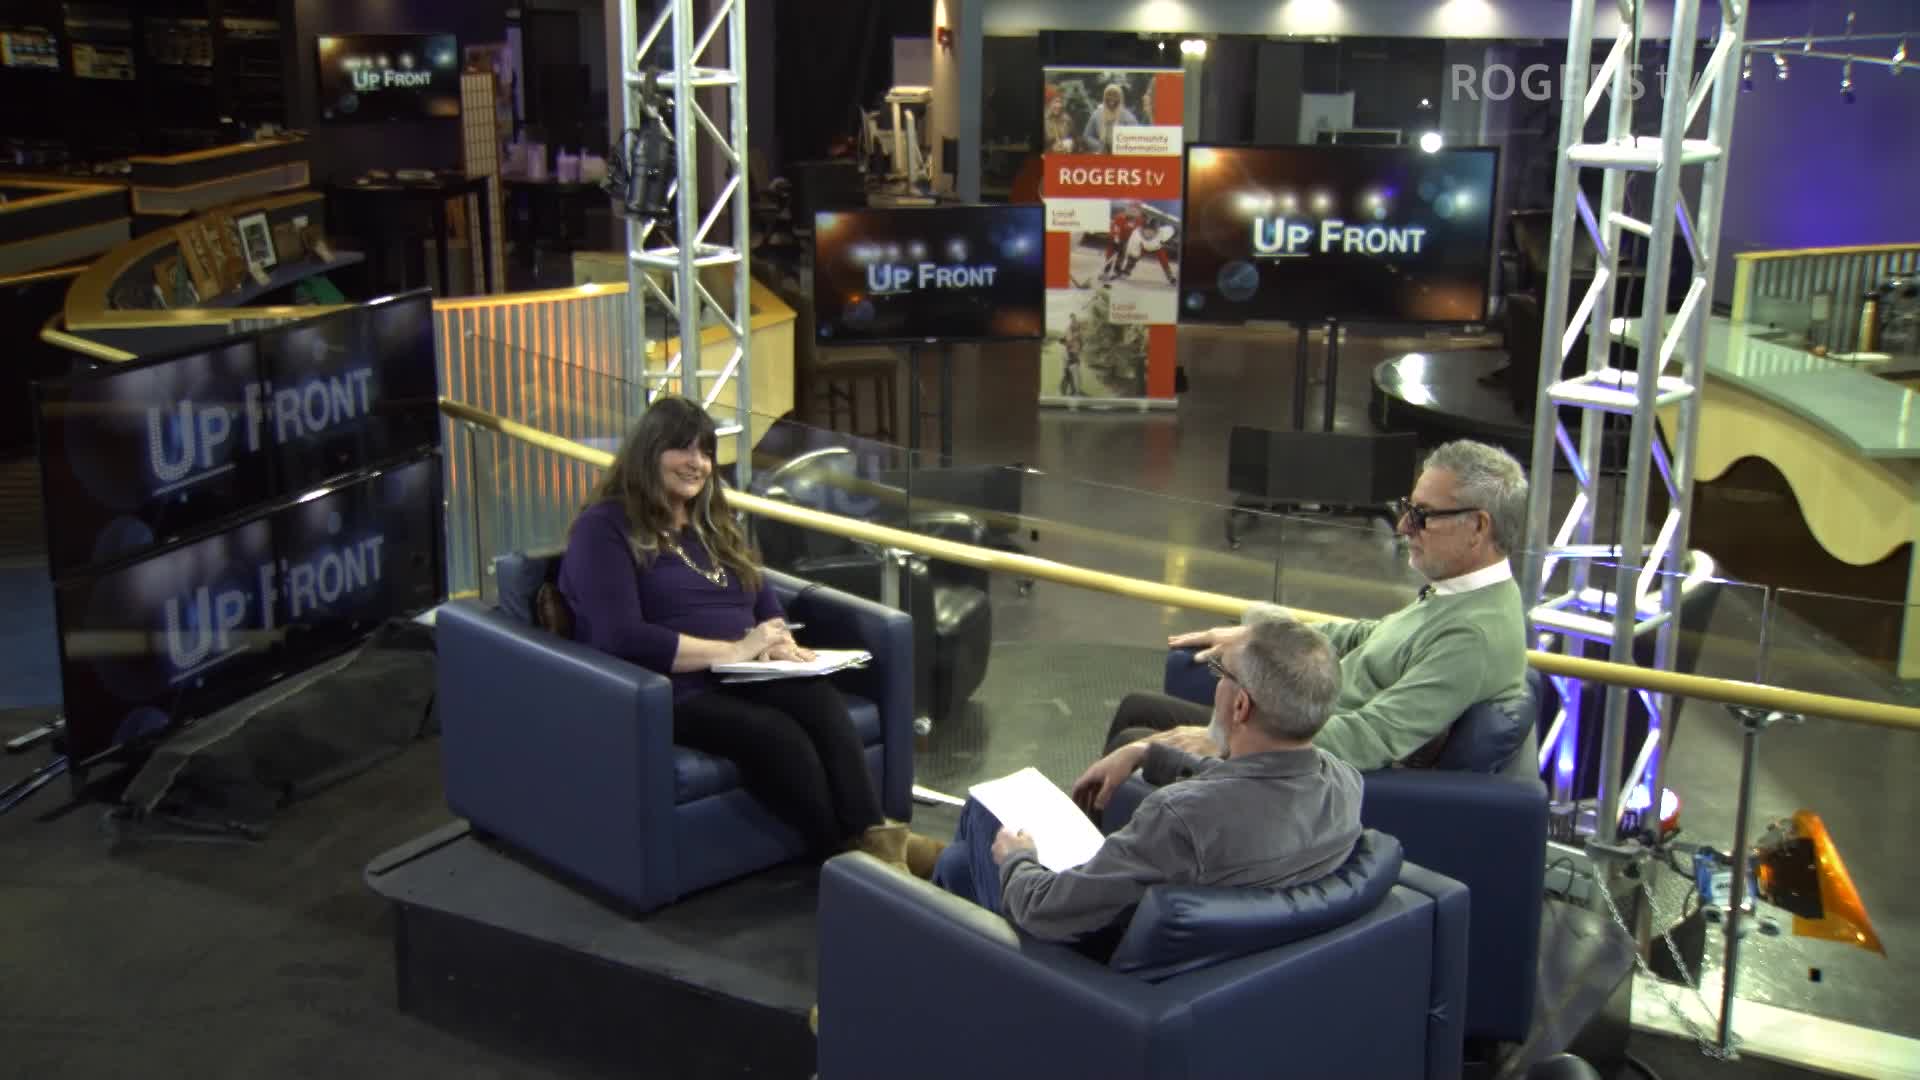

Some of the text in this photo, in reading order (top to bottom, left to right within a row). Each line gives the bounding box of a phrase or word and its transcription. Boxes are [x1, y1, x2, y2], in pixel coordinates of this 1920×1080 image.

[353, 69, 431, 89] UP FRONT
[1116, 133, 1169, 144] Community
[1116, 144, 1169, 152] Information
[1059, 168, 1166, 186] ROGERS tv
[1253, 217, 1427, 254] UP FRONT
[867, 263, 997, 292] UP FRONT
[149, 367, 373, 481] UP FRONT
[164, 535, 385, 669] UP FRONT
